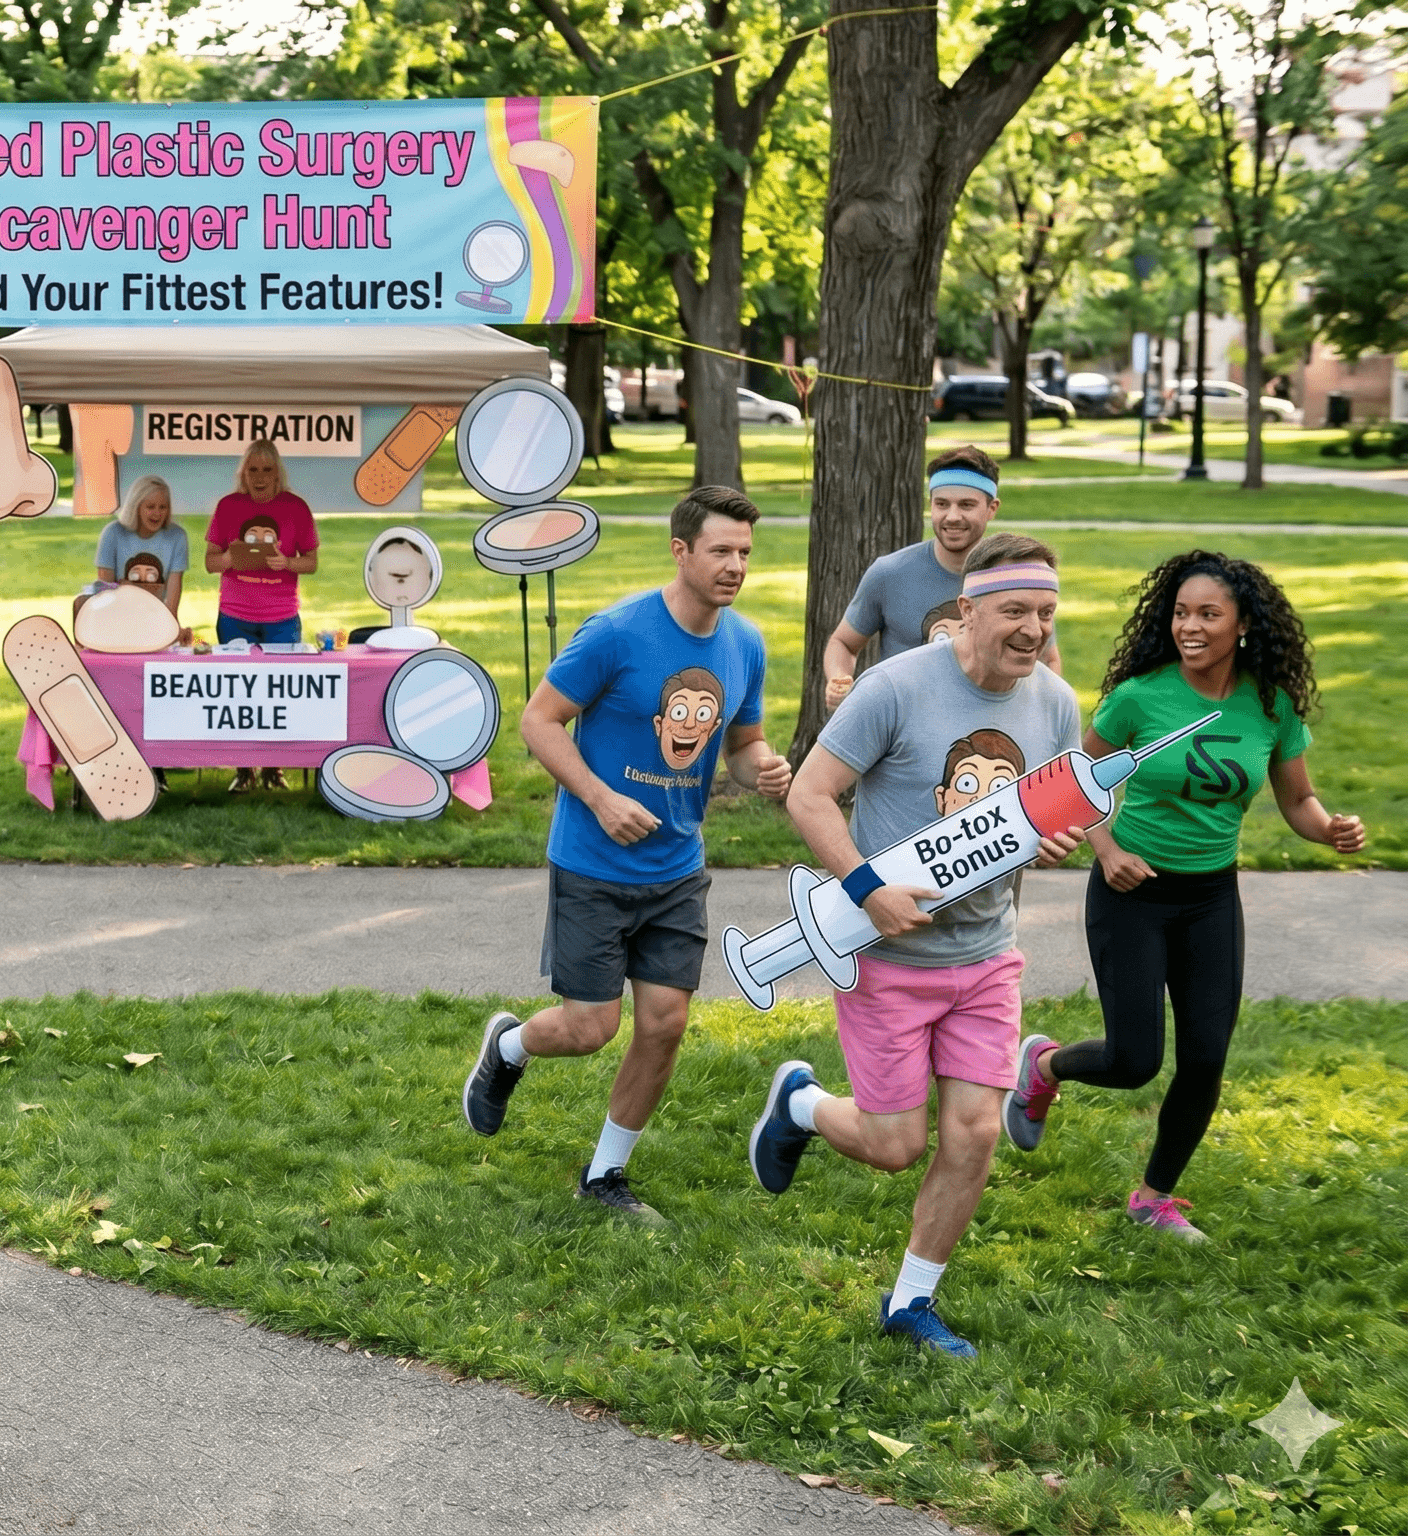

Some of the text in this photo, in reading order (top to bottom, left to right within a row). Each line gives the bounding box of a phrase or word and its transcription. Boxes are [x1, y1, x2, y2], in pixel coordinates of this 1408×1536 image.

[61, 120, 244, 177] Plastic
[259, 119, 475, 188] Surgery
[264, 194, 392, 249] Hunt
[22, 273, 109, 311] Your
[123, 273, 246, 311] Fittest
[260, 272, 442, 310] Features!
[148, 413, 354, 441] REGISTRATION
[151, 674, 341, 699] BEAUTY HUNT
[202, 705, 287, 729] TABLE
[914, 805, 1008, 865] Bo-tox
[929, 833, 1020, 889] Bonus
